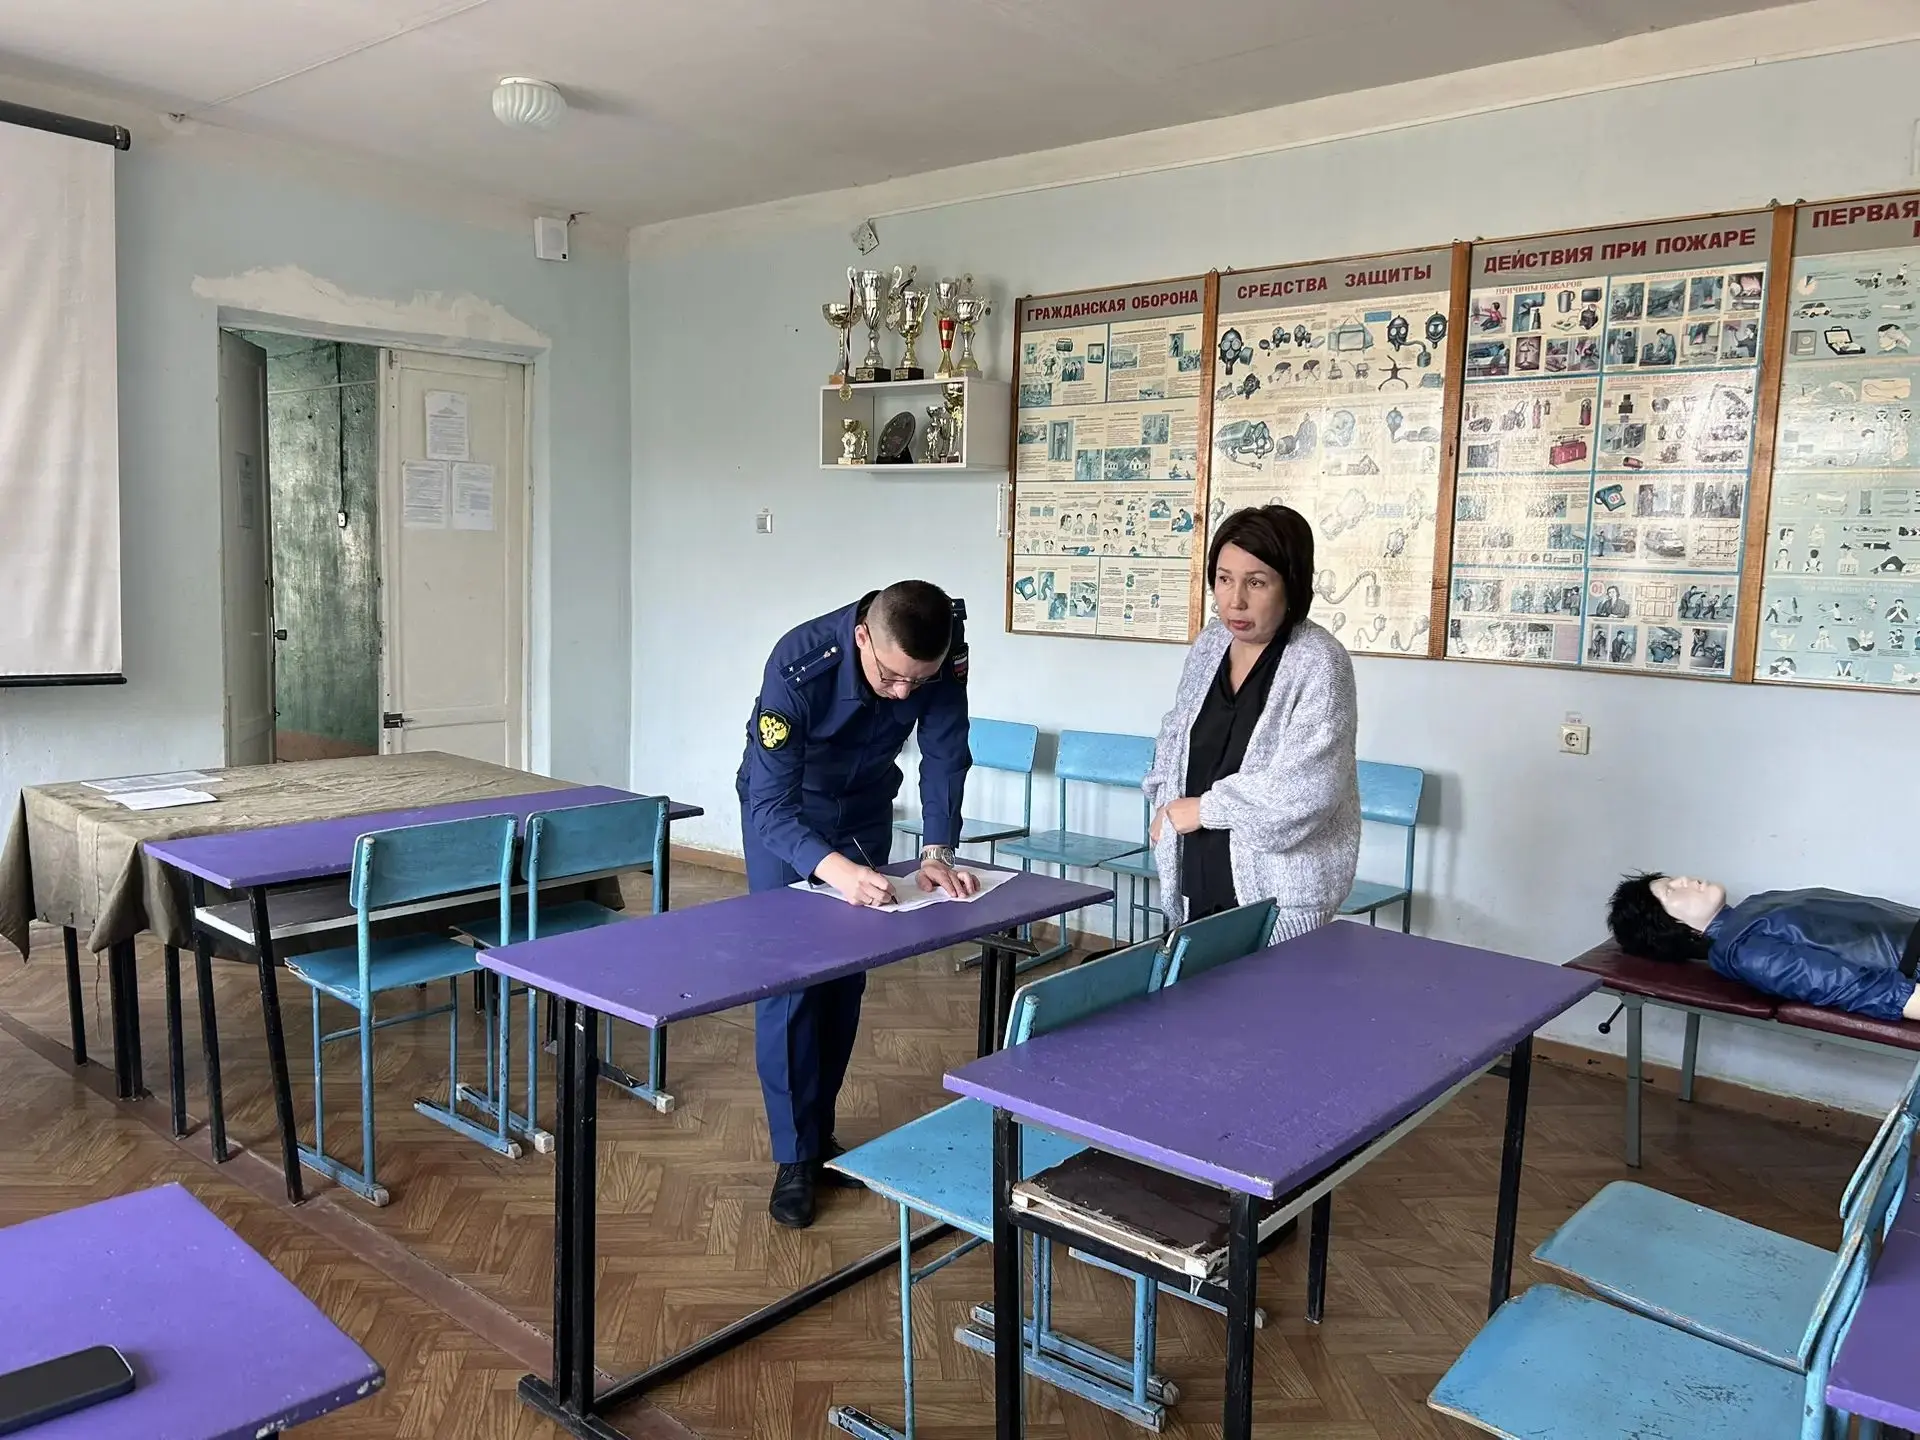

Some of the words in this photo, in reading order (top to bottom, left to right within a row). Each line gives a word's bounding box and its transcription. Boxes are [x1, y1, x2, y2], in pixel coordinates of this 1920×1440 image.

[1812, 200, 1919, 228] ПЕРВАЯ
[1484, 246, 1593, 273] ДЕЙСТВИЯ
[1601, 240, 1647, 260] ПРИ
[1655, 228, 1756, 255] ПОЖАРЕ
[1237, 276, 1328, 299] СРЕДСТВА
[1345, 264, 1432, 288] ЗАЩИТЫ
[1496, 284, 1539, 295] ПРИЧИНЫ
[1540, 280, 1582, 291] ПОЖАРОВ
[1027, 298, 1126, 321] ГРАЖДАНСКАЯ
[1132, 289, 1198, 309] ОБОРОНА
